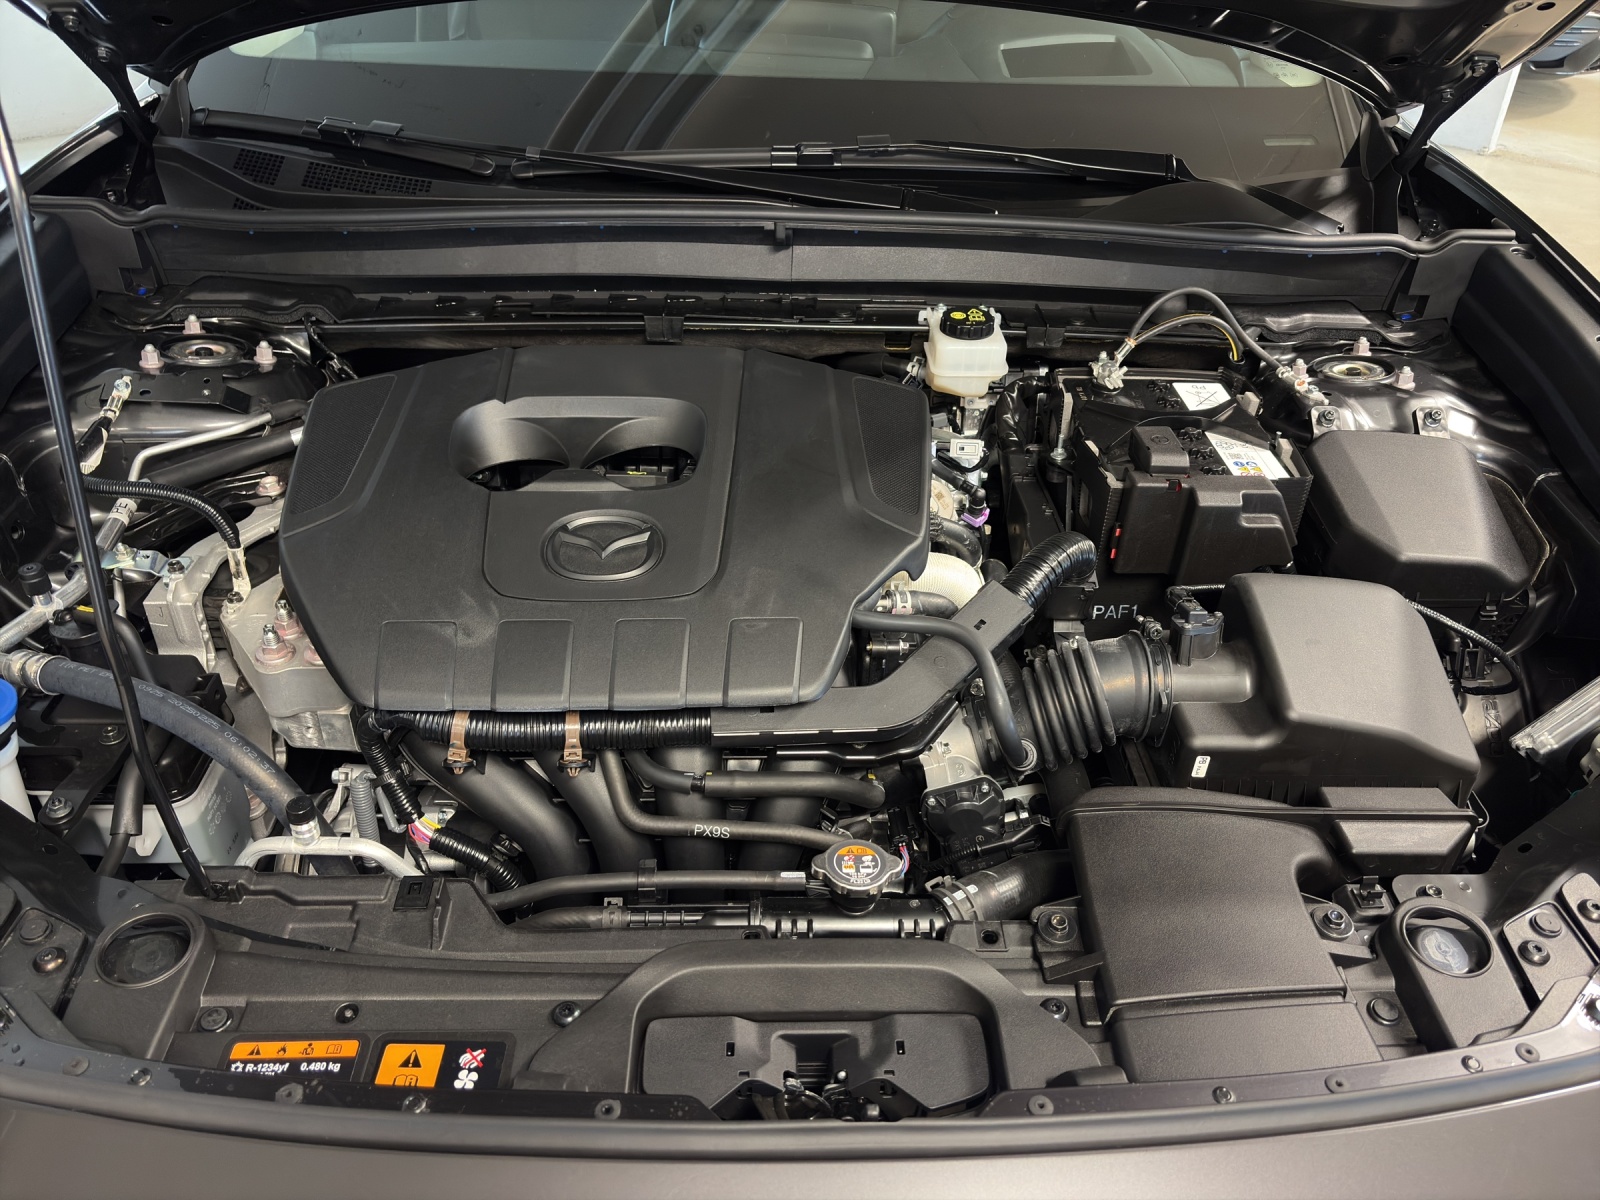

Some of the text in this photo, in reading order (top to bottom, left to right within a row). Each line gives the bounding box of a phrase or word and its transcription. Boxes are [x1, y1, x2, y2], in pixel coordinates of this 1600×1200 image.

[1092, 604, 1138, 620] PAF1
[138, 684, 164, 698] 0925
[168, 697, 221, 730] 20250225
[224, 731, 276, 773] 06:02:37
[694, 823, 730, 839] PX9S
[245, 1061, 341, 1073] R-1234yf 0.480 kg
